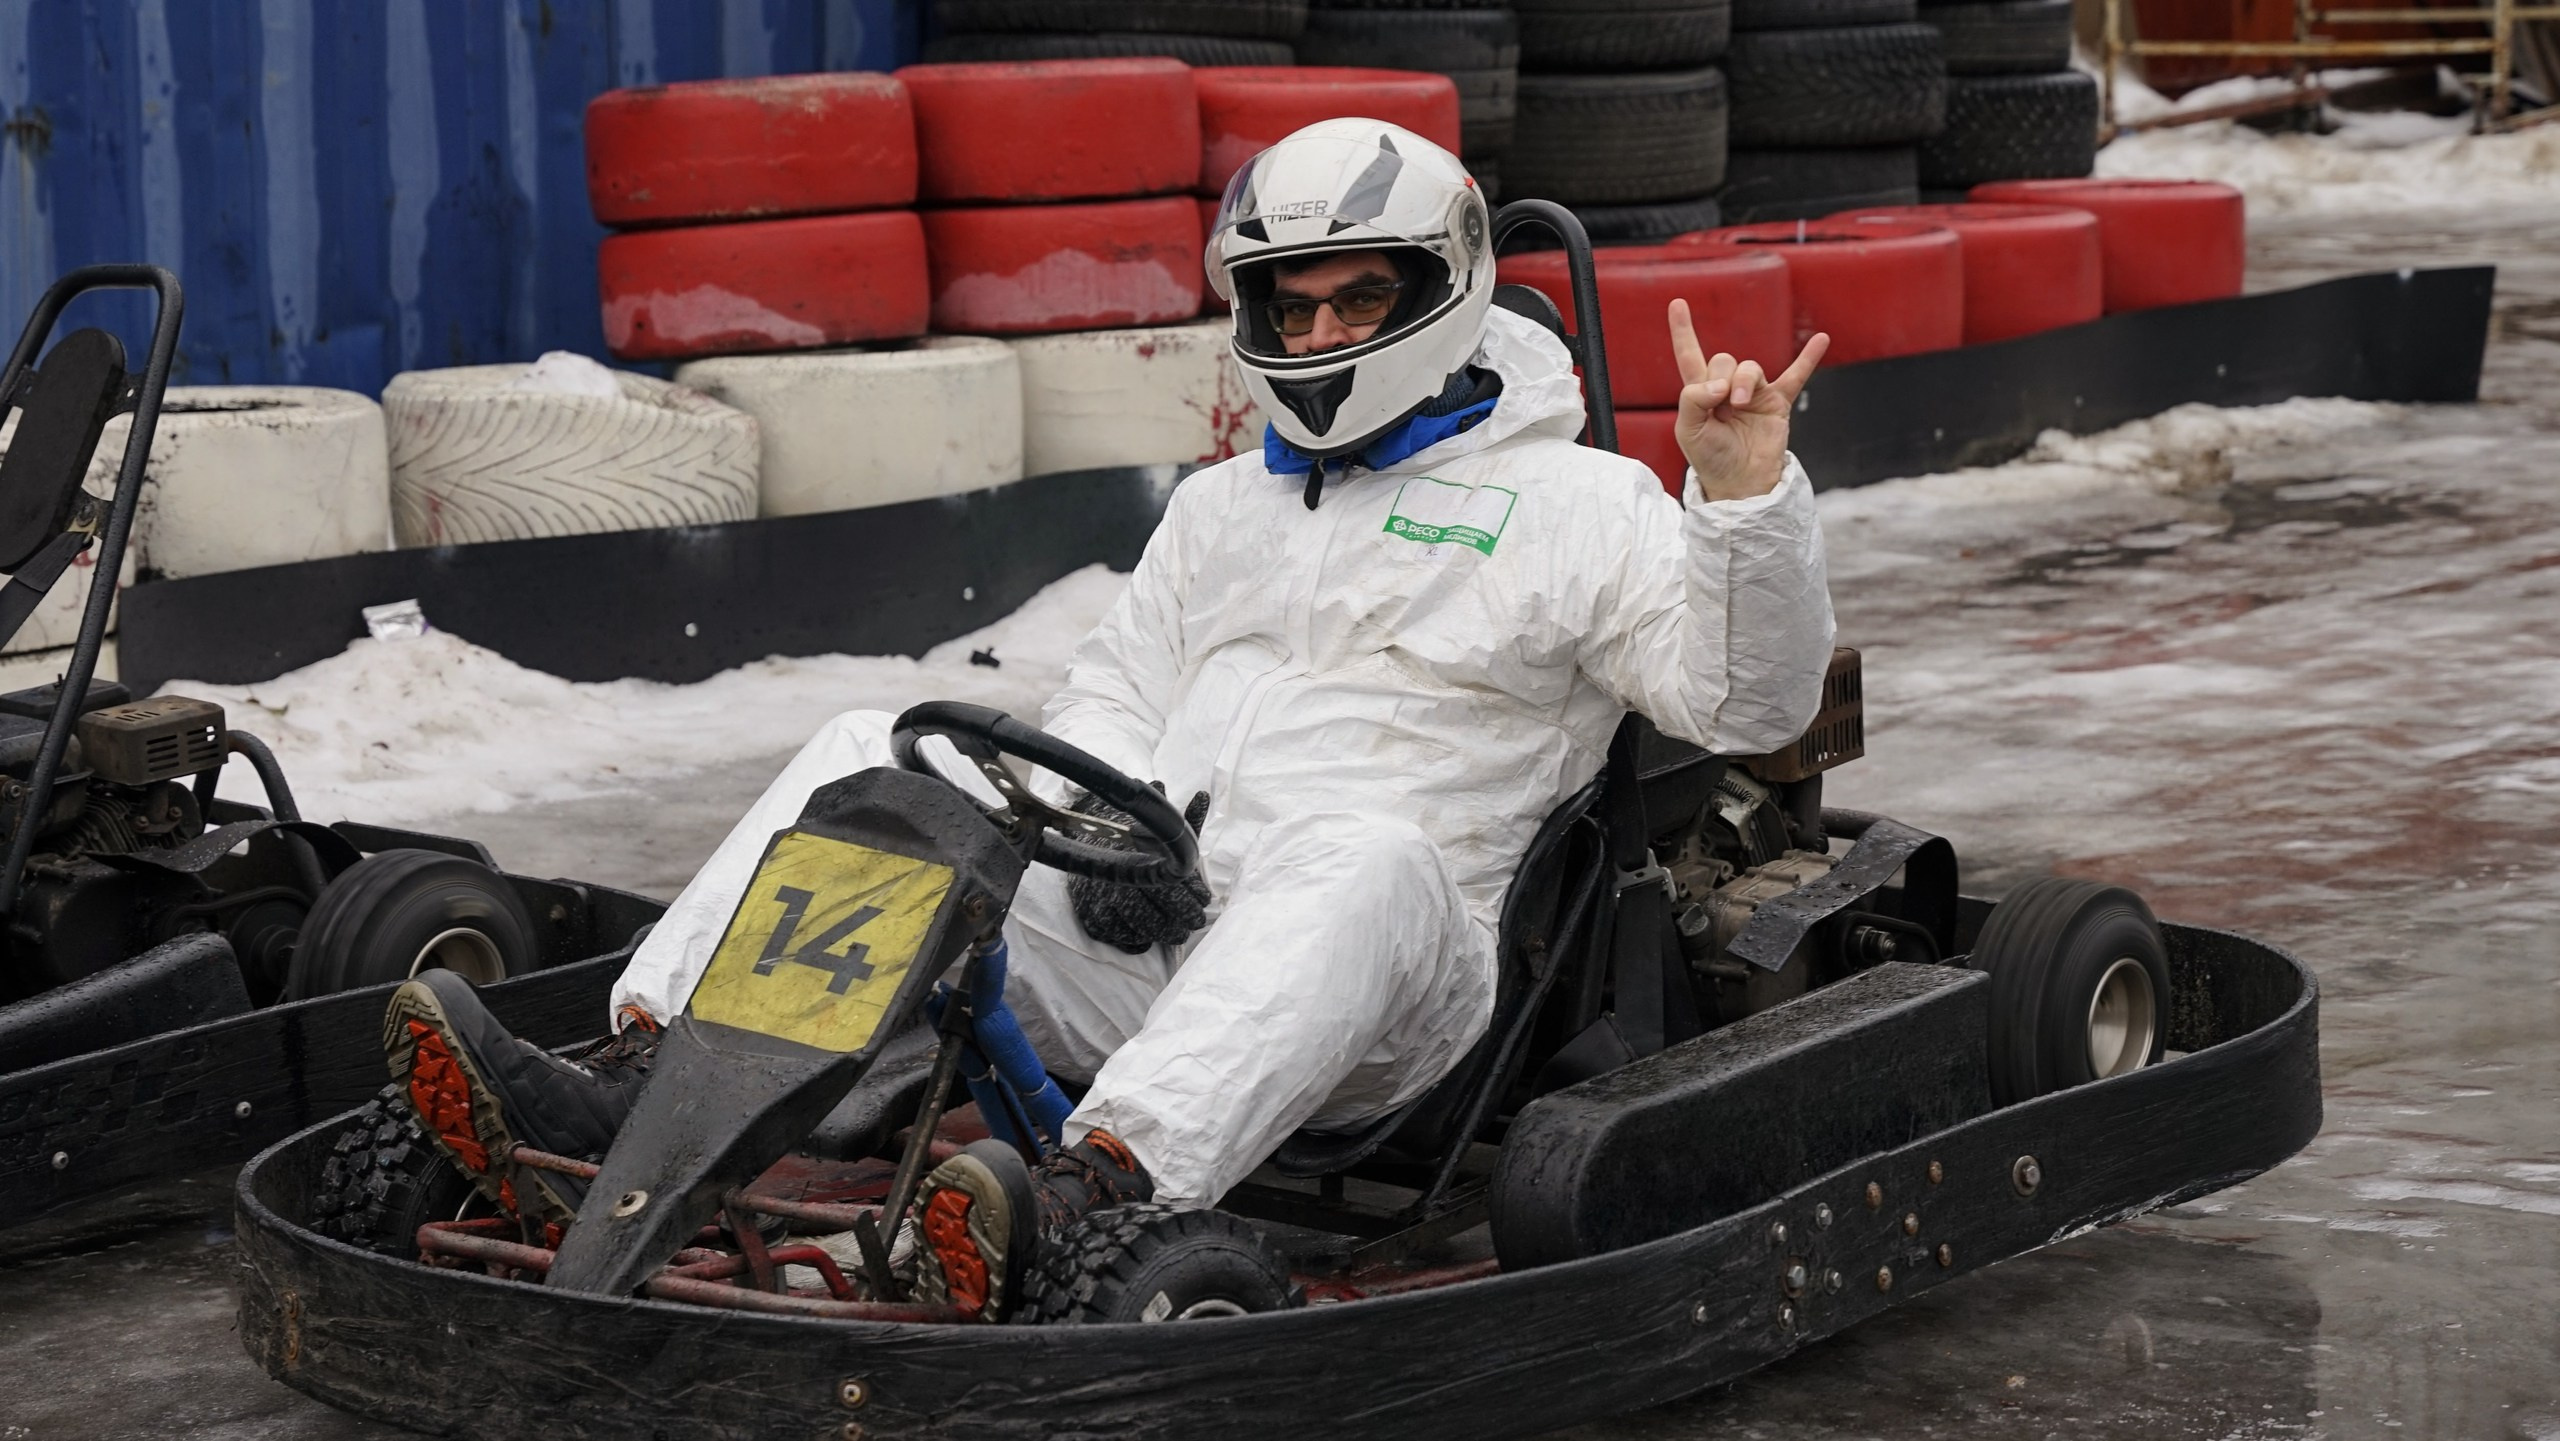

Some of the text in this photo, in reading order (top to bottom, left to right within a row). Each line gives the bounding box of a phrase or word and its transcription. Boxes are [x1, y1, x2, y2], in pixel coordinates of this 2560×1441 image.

[1270, 200, 1329, 224] HIZER
[1407, 524, 1440, 538] РЕСО
[752, 885, 886, 995] 14
